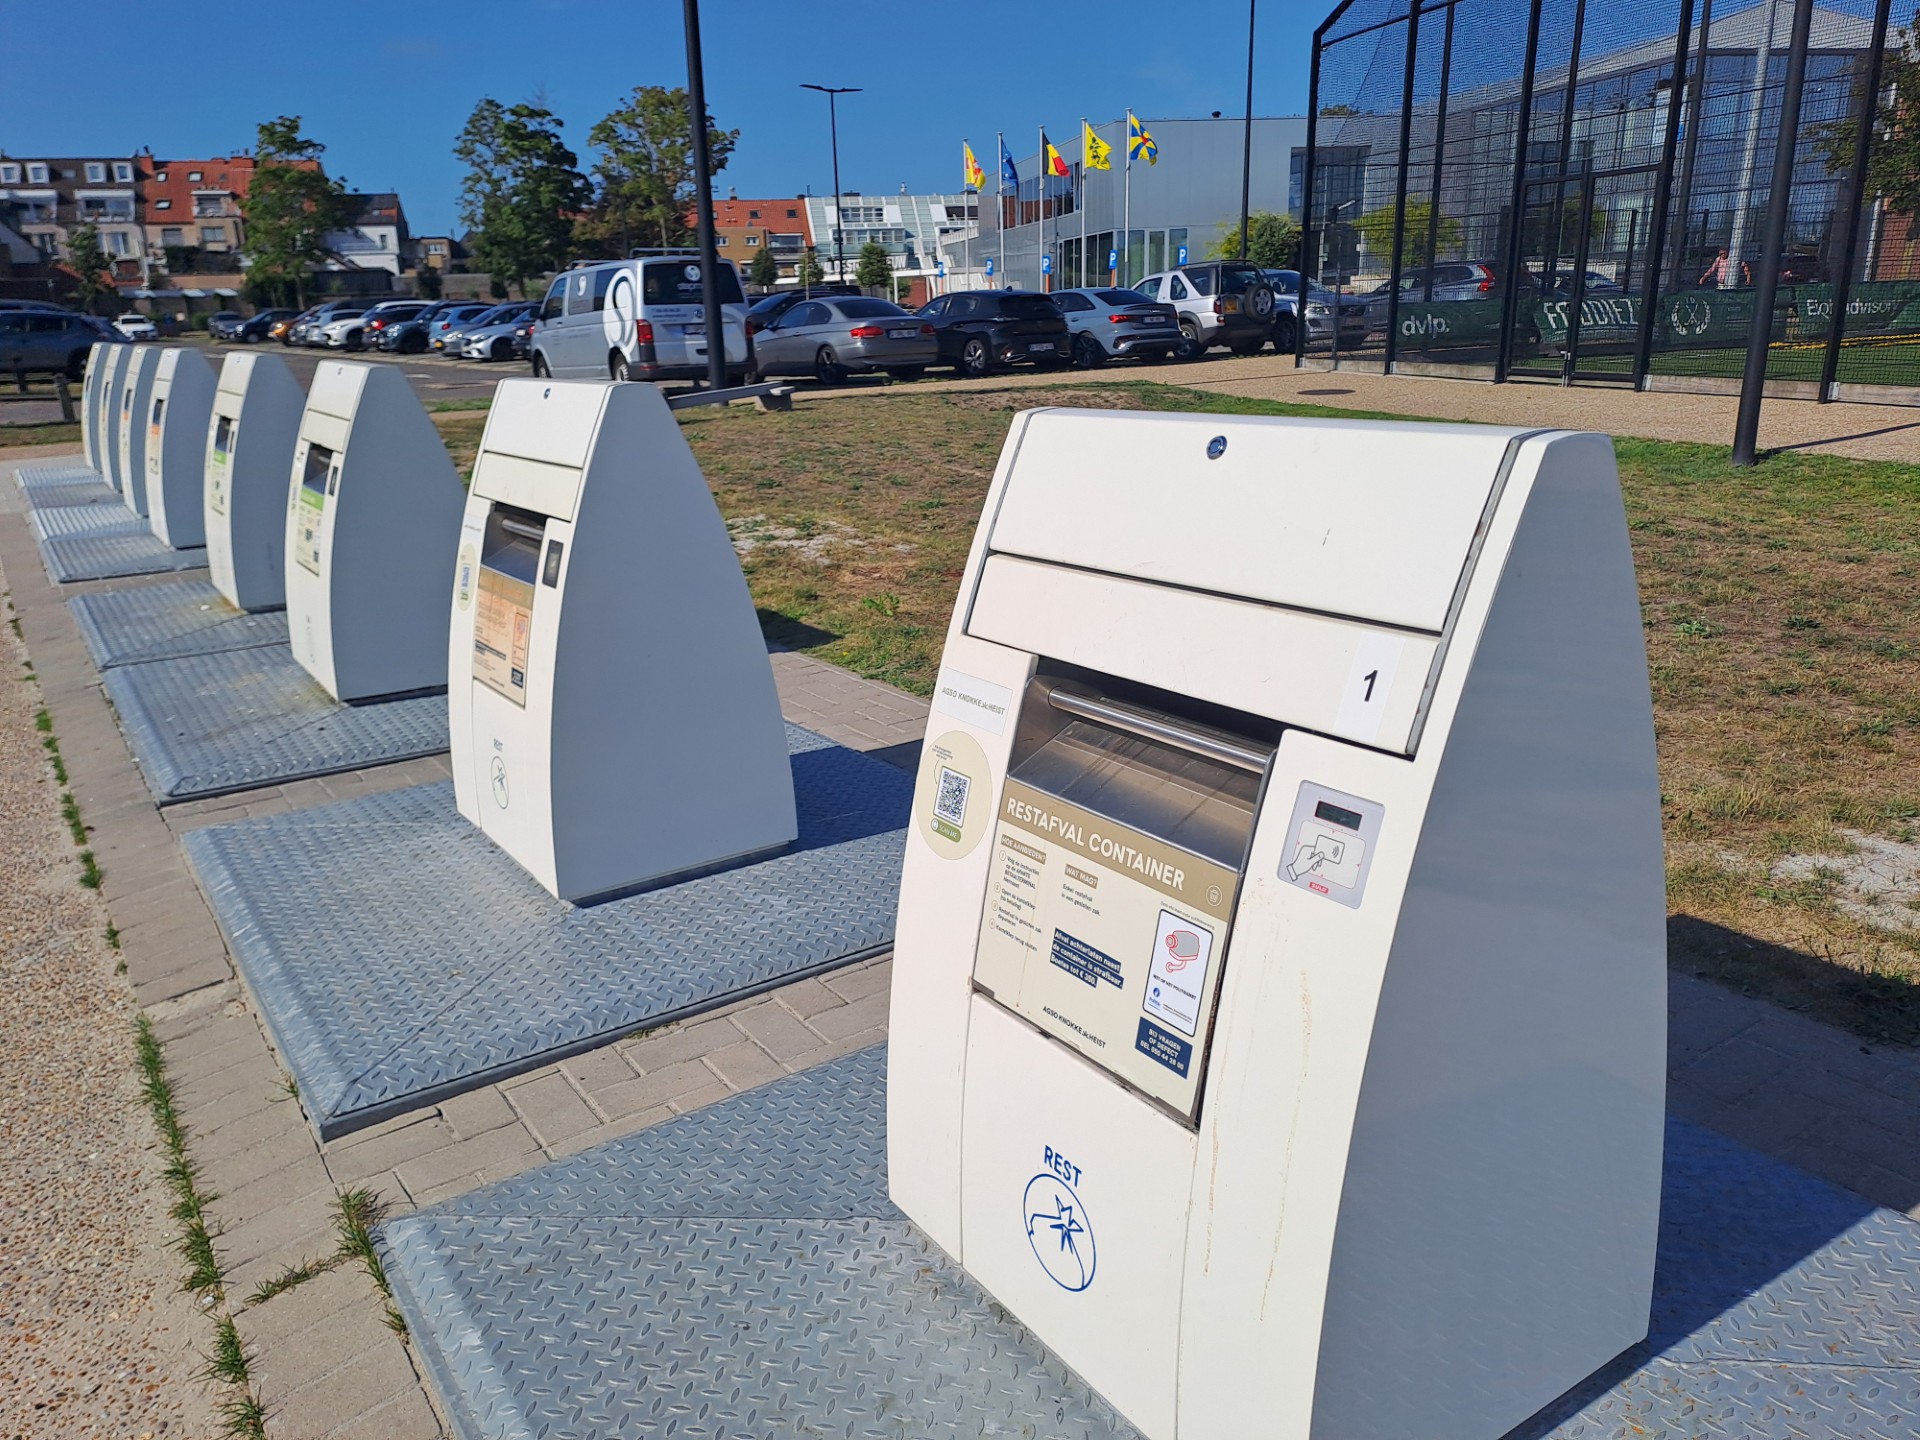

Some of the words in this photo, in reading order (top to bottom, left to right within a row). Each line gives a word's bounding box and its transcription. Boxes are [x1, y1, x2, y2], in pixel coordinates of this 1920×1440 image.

[1401, 313, 1450, 339] dvlp.
[942, 686, 958, 698] AGSO
[1363, 669, 1379, 703] 1
[1001, 835, 1014, 847] HOE
[1006, 797, 1085, 847] RESTAFVAL
[1088, 833, 1185, 891] CONTAINER
[1066, 866, 1080, 879] WAT
[1080, 871, 1098, 888] MAG?
[1052, 943, 1060, 952] de
[1060, 948, 1088, 967] container
[1055, 930, 1069, 944] Afval
[1069, 940, 1103, 963] achterlaten
[1103, 958, 1121, 972] naast
[1050, 953, 1069, 970] Boetes
[1070, 965, 1079, 976] tot
[1042, 1005, 1059, 1019] AGSO
[1059, 1015, 1082, 1035] KNOKKE
[1089, 1033, 1106, 1049] HEIST
[1148, 1037, 1157, 1045] OF
[1157, 1041, 1179, 1059] DEFECT
[1158, 1034, 1181, 1052] VRAGEN
[1043, 1144, 1083, 1188] REST
